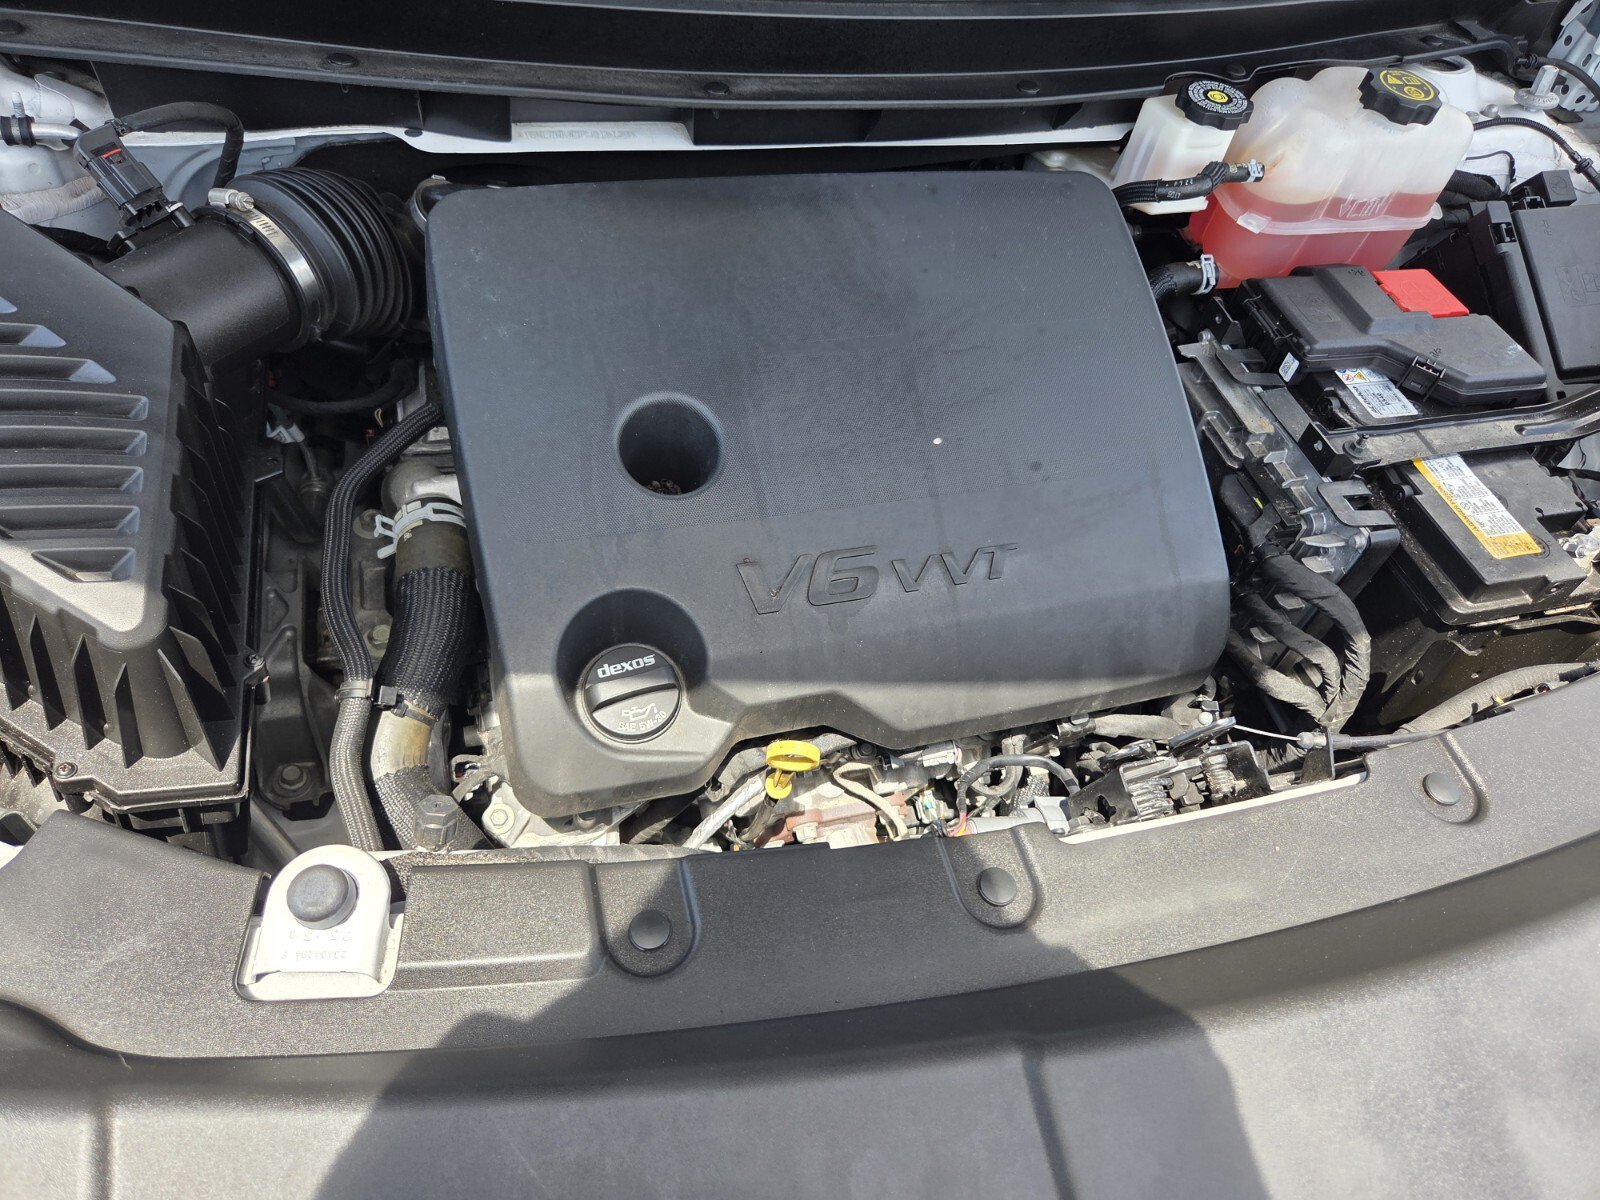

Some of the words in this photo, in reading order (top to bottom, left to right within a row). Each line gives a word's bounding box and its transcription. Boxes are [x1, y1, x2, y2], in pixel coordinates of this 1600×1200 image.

[736, 544, 879, 615] V6
[892, 542, 1018, 593] VVT
[597, 653, 656, 679] dexos
[618, 721, 637, 732] SAE
[639, 711, 667, 731] 5W-30
